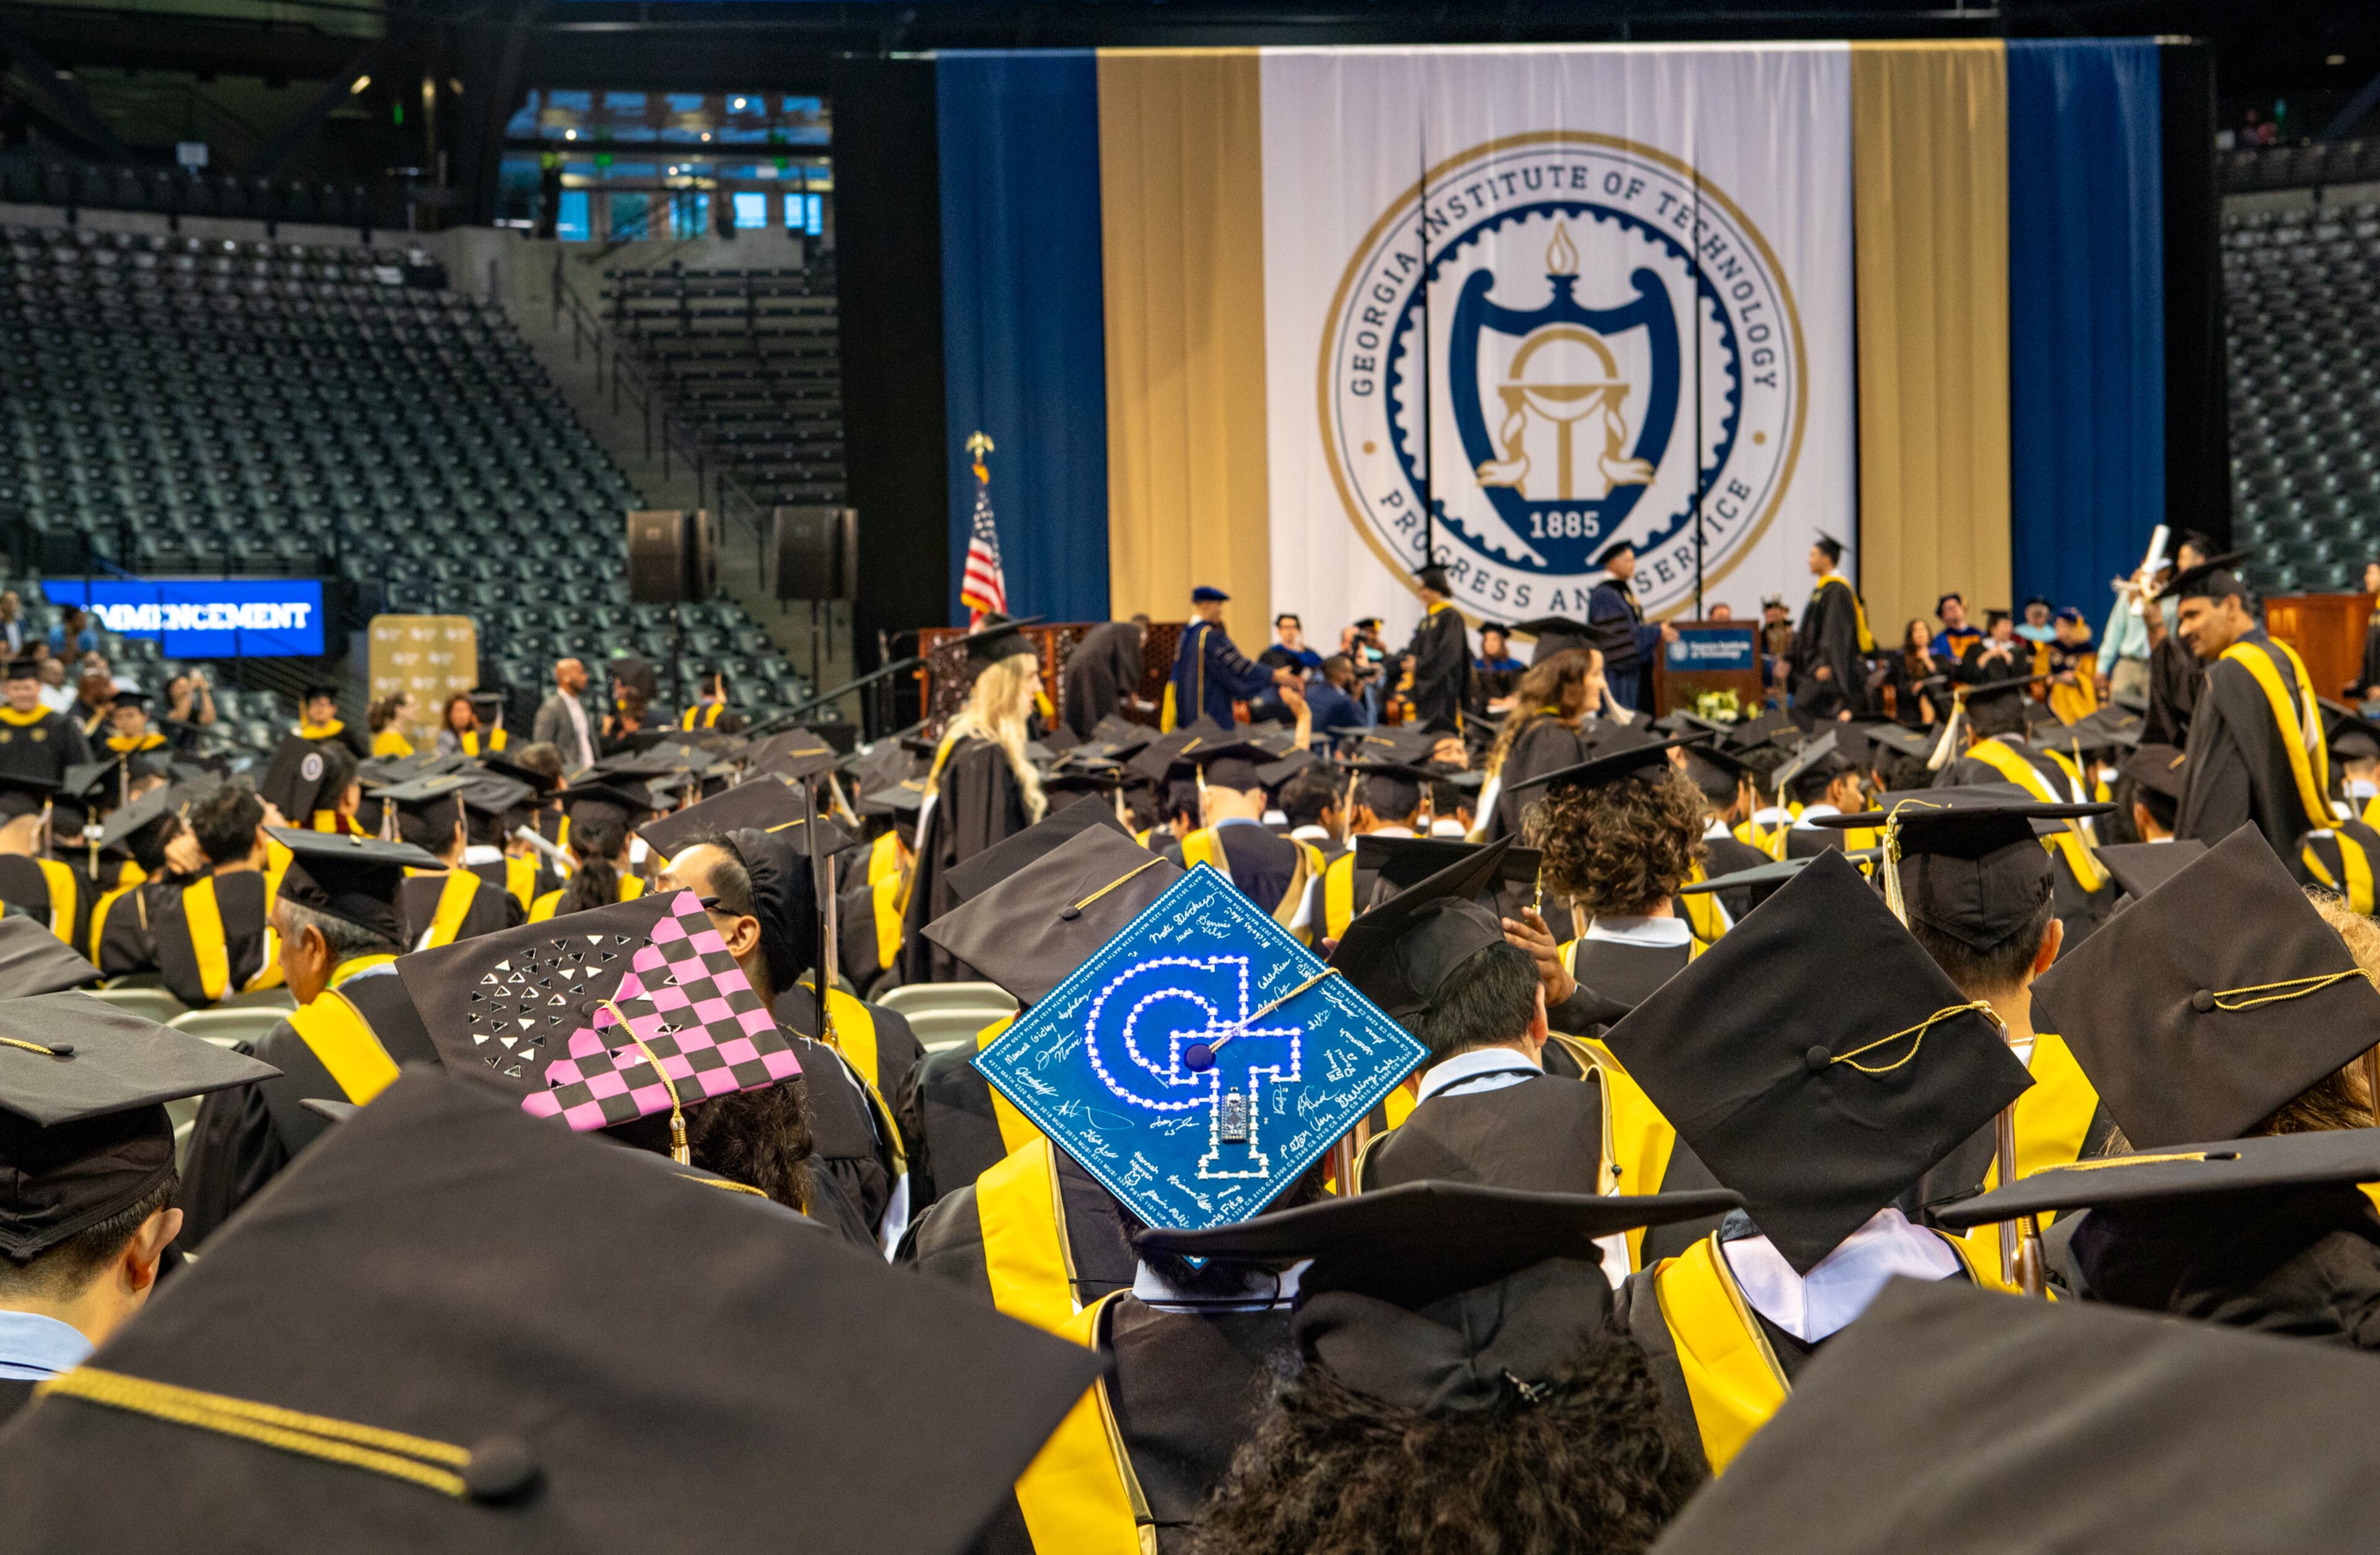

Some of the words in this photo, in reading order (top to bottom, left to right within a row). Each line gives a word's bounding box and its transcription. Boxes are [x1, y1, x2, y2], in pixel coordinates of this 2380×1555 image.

[1351, 252, 1418, 396] GEORGIA
[1416, 165, 1589, 244] INSTITUTE
[1603, 171, 1646, 200] OF
[1657, 191, 1777, 389] TECHNOLOGY
[1530, 511, 1600, 539] 1885
[1380, 490, 1532, 607] PROGRESS
[1549, 587, 1592, 611] AN
[1634, 478, 1751, 594] SERVICE
[91, 603, 311, 630] MMENCEMENT
[1188, 875, 1202, 888] MATH
[1206, 880, 1218, 892] 2106
[1176, 888, 1188, 899] 3012
[1218, 890, 1232, 903] MATH
[1161, 899, 1176, 912] MATH
[1233, 902, 1243, 913] 1554
[1149, 912, 1161, 922] 3235
[1245, 913, 1259, 925] MATH
[1134, 922, 1149, 935] MATH
[1243, 921, 1271, 948] Nicholas
[1259, 926, 1271, 936] 2031
[1122, 935, 1134, 946] 3236
[1271, 935, 1283, 946] ECE
[1107, 946, 1122, 959] MATH
[1283, 945, 1294, 956] 7641
[1080, 970, 1095, 983] MATH
[1067, 984, 1078, 995] 4022
[1324, 980, 1336, 990] 4510
[1052, 995, 1067, 1008] MATH
[1344, 997, 1357, 1008] 4476
[1039, 1007, 1051, 1019] 4107
[1023, 1018, 1039, 1031] MATH
[1010, 1032, 1023, 1042] 4150
[995, 1042, 1011, 1056] MATH
[989, 1060, 1000, 1070] 4317
[1000, 1070, 1014, 1083] MATH
[1015, 1083, 1026, 1094] 4320
[1026, 1094, 1039, 1106] MUSI
[1052, 1117, 1065, 1129] MUSI
[1077, 1140, 1091, 1153] MUSI
[1091, 1153, 1103, 1163] 3311
[1103, 1163, 1116, 1176] MUSI
[1129, 1187, 1144, 1200] PSYC
[1145, 1201, 1156, 1211] 1101
[1157, 1212, 1166, 1220] VIP
[1232, 1205, 1244, 1217] 1332
[1253, 1186, 1265, 1198] 2110
[1273, 1166, 1287, 1179] 2200
[1295, 1147, 1308, 1160] 2340
[1316, 1128, 1329, 1139] 3210
[1329, 1120, 1337, 1128] CS
[1337, 1108, 1350, 1120] 3220
[1357, 1089, 1370, 1101] 3510
[1378, 1068, 1391, 1081] 3600
[1399, 1051, 1411, 1062] 3630
[1134, 1151, 1159, 1174] Hannah
[1129, 1159, 1153, 1182] Nguyen
